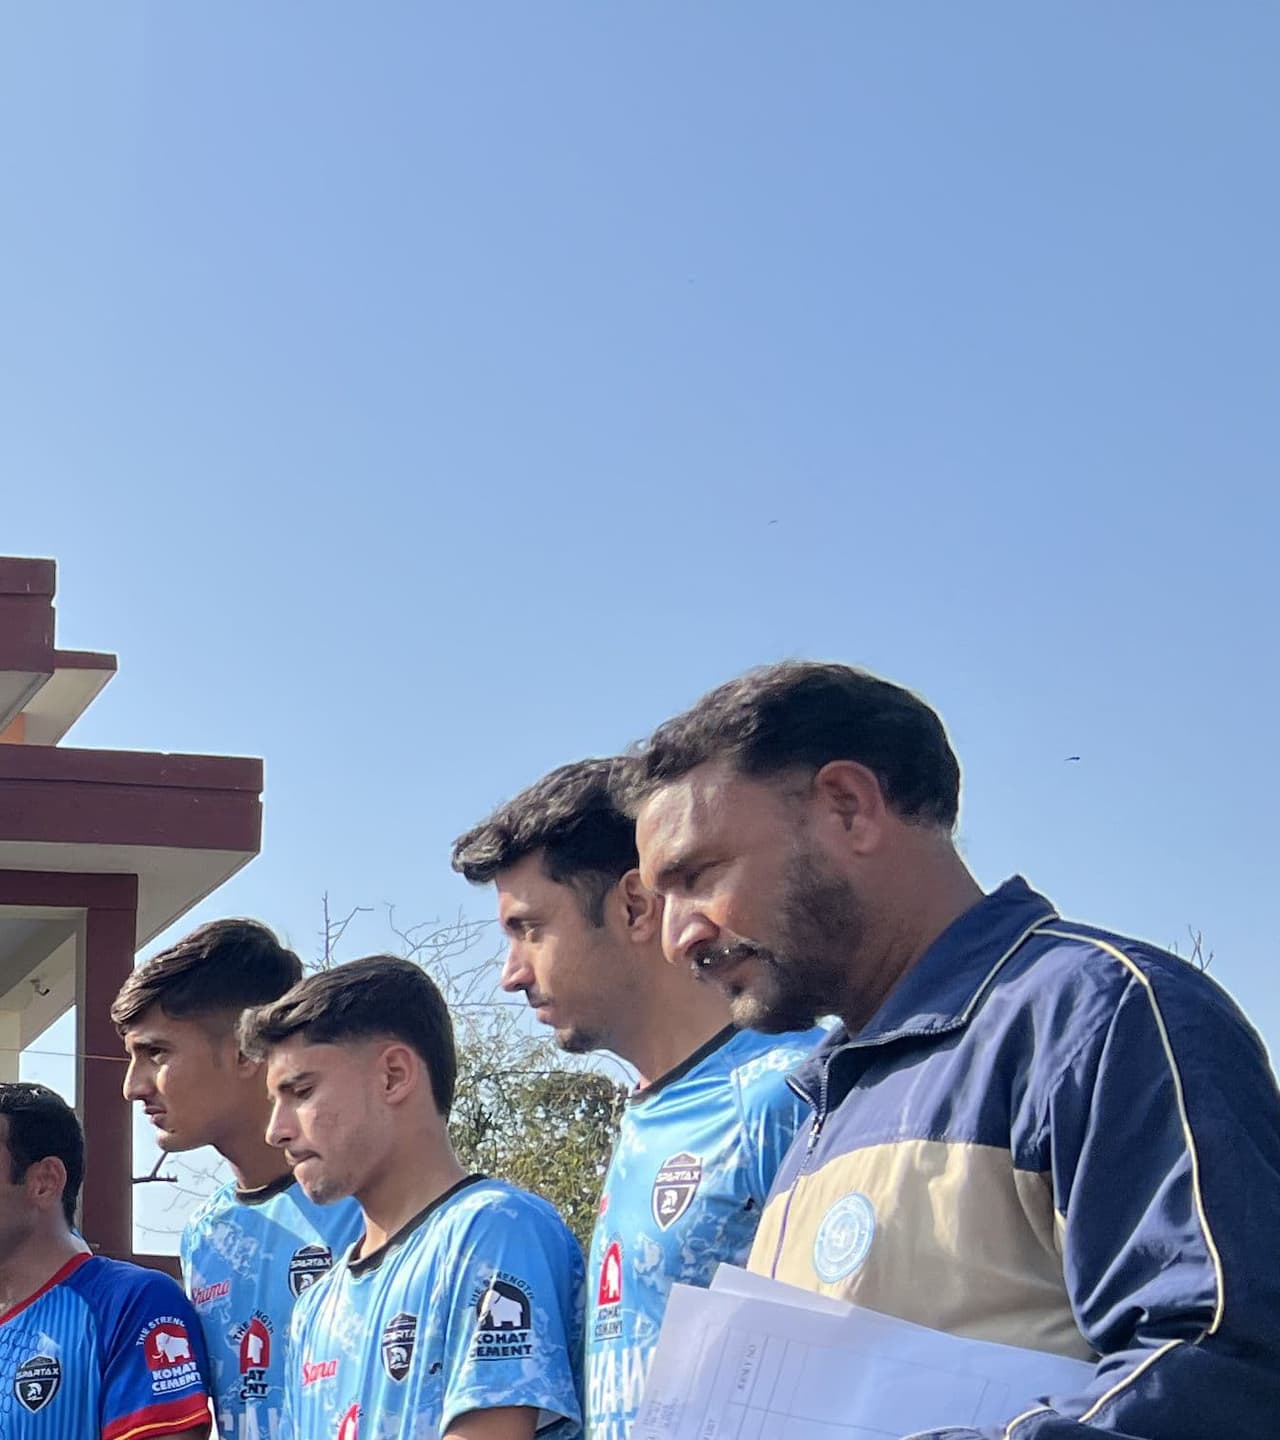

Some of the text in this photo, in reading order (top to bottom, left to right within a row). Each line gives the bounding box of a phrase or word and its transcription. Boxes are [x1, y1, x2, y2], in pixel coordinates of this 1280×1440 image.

[655, 1170, 701, 1184] SPARTAX
[135, 1327, 151, 1347] THE
[472, 1344, 533, 1357] EMENT
[15, 1367, 61, 1380] SPARTAX
[151, 1362, 197, 1381] KOHAT
